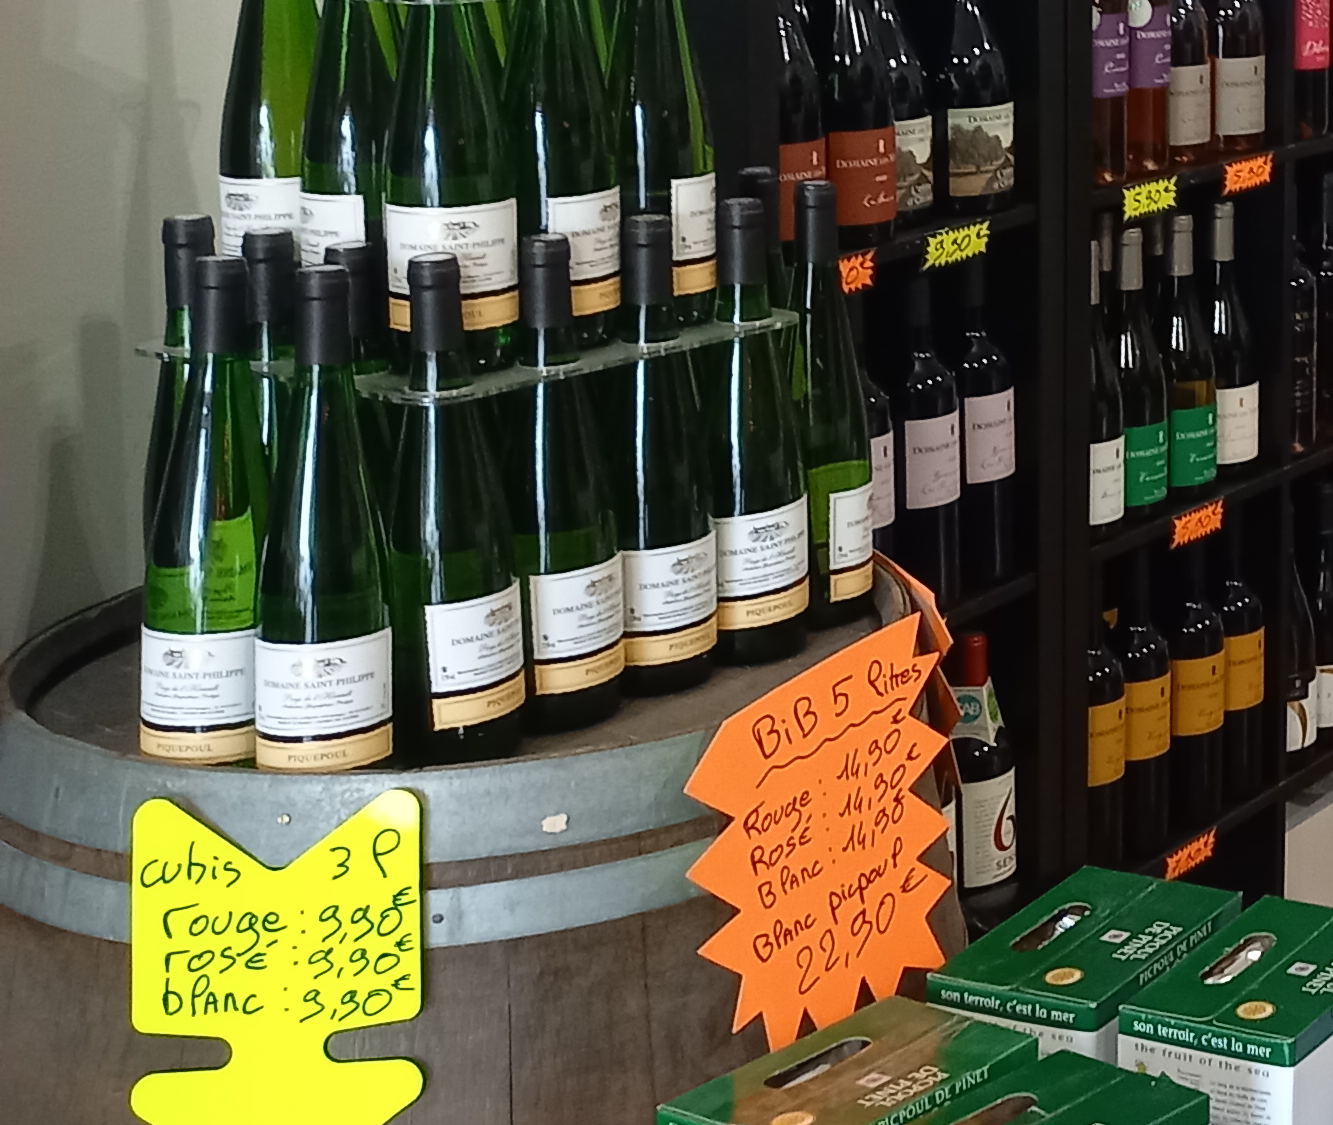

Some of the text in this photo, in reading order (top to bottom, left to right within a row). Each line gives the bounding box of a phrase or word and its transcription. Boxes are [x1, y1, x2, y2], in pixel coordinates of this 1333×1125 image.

[832, 675, 854, 718] 5
[287, 749, 349, 763] PIQUEPOUL
[329, 846, 352, 881] 3
[162, 902, 288, 957] rouge
[940, 986, 961, 1003] son
[1006, 999, 1034, 1018] c'est
[1035, 1003, 1048, 1019] la
[1050, 1008, 1076, 1025] mer
[1132, 1018, 1154, 1034] son
[1200, 1032, 1229, 1052] c'est
[1230, 1037, 1244, 1053] la
[1246, 1043, 1273, 1060] mer
[953, 1066, 993, 1096] PINET
